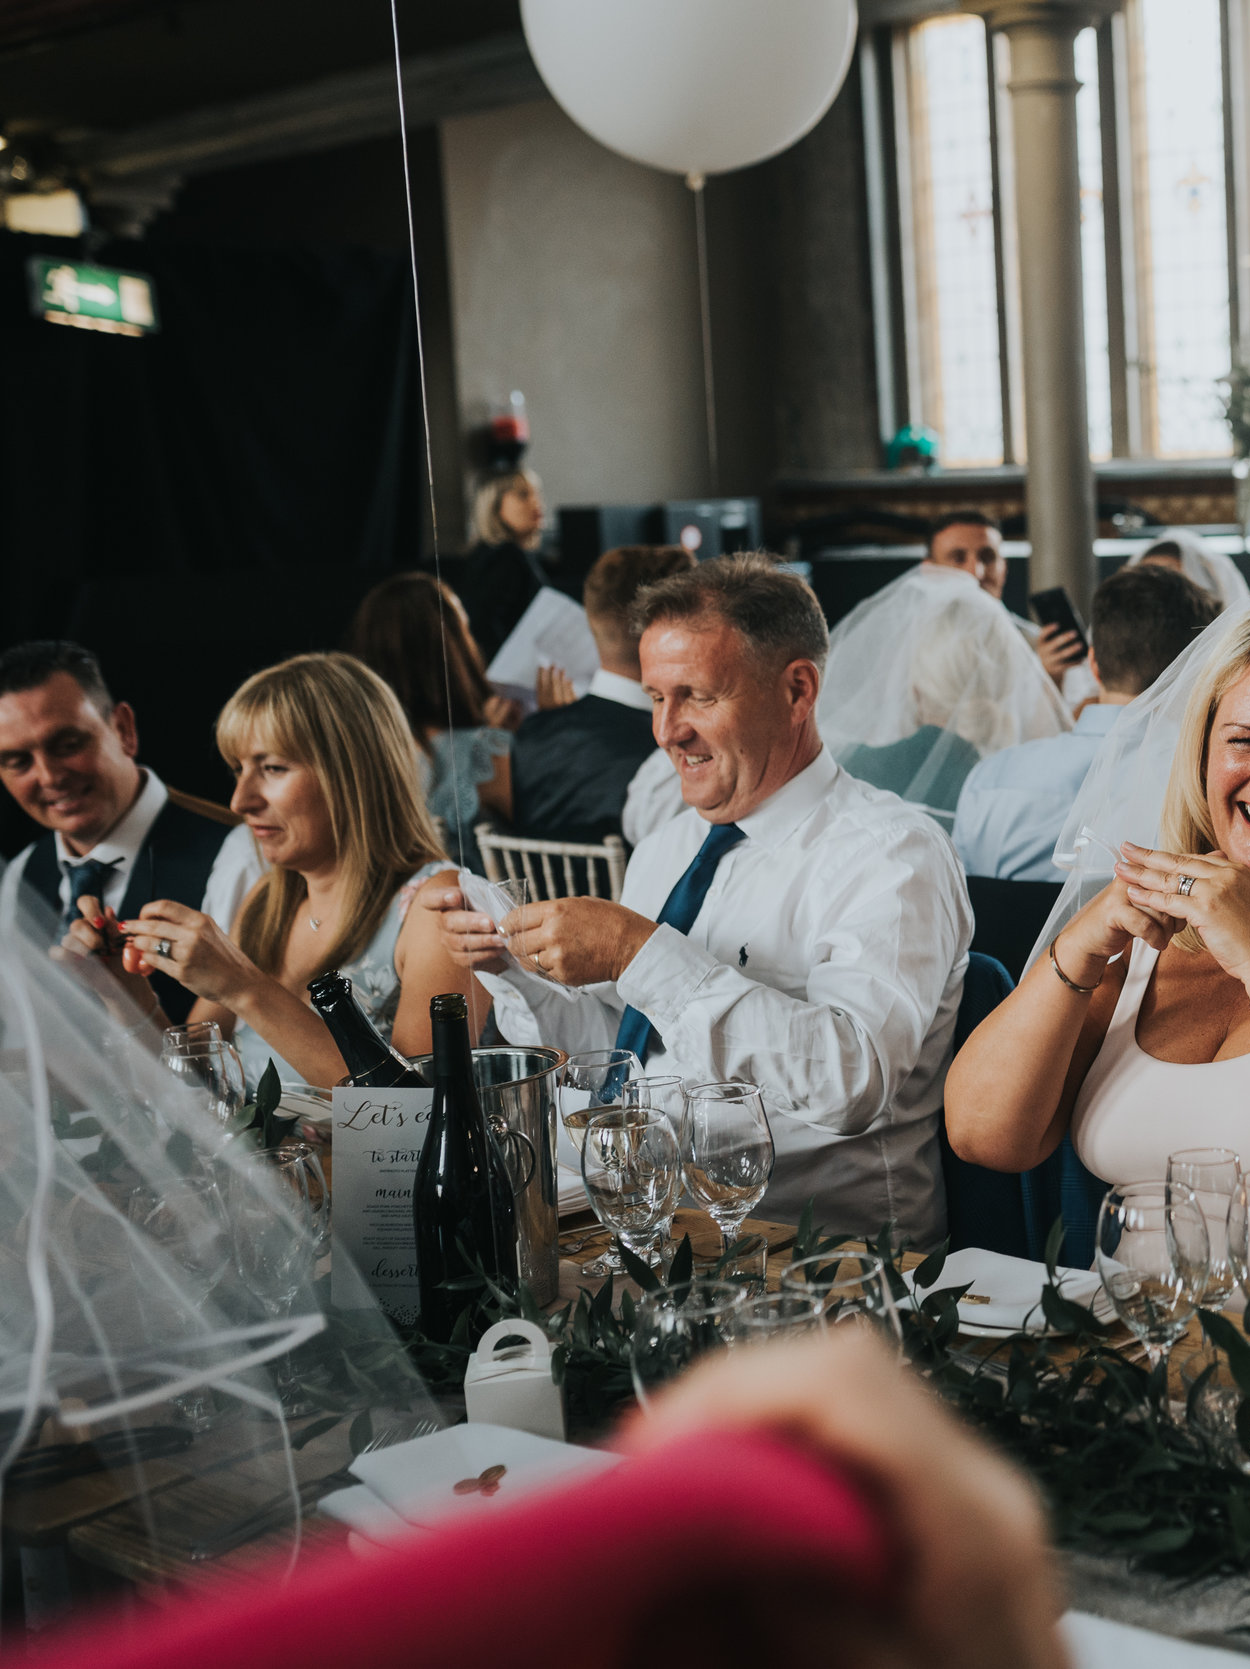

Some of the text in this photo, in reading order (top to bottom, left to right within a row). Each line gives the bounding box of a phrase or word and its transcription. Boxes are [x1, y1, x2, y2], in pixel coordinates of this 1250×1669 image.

[337, 1100, 408, 1131] Let's
[363, 1147, 421, 1164] to start
[371, 1257, 418, 1279] dessert
